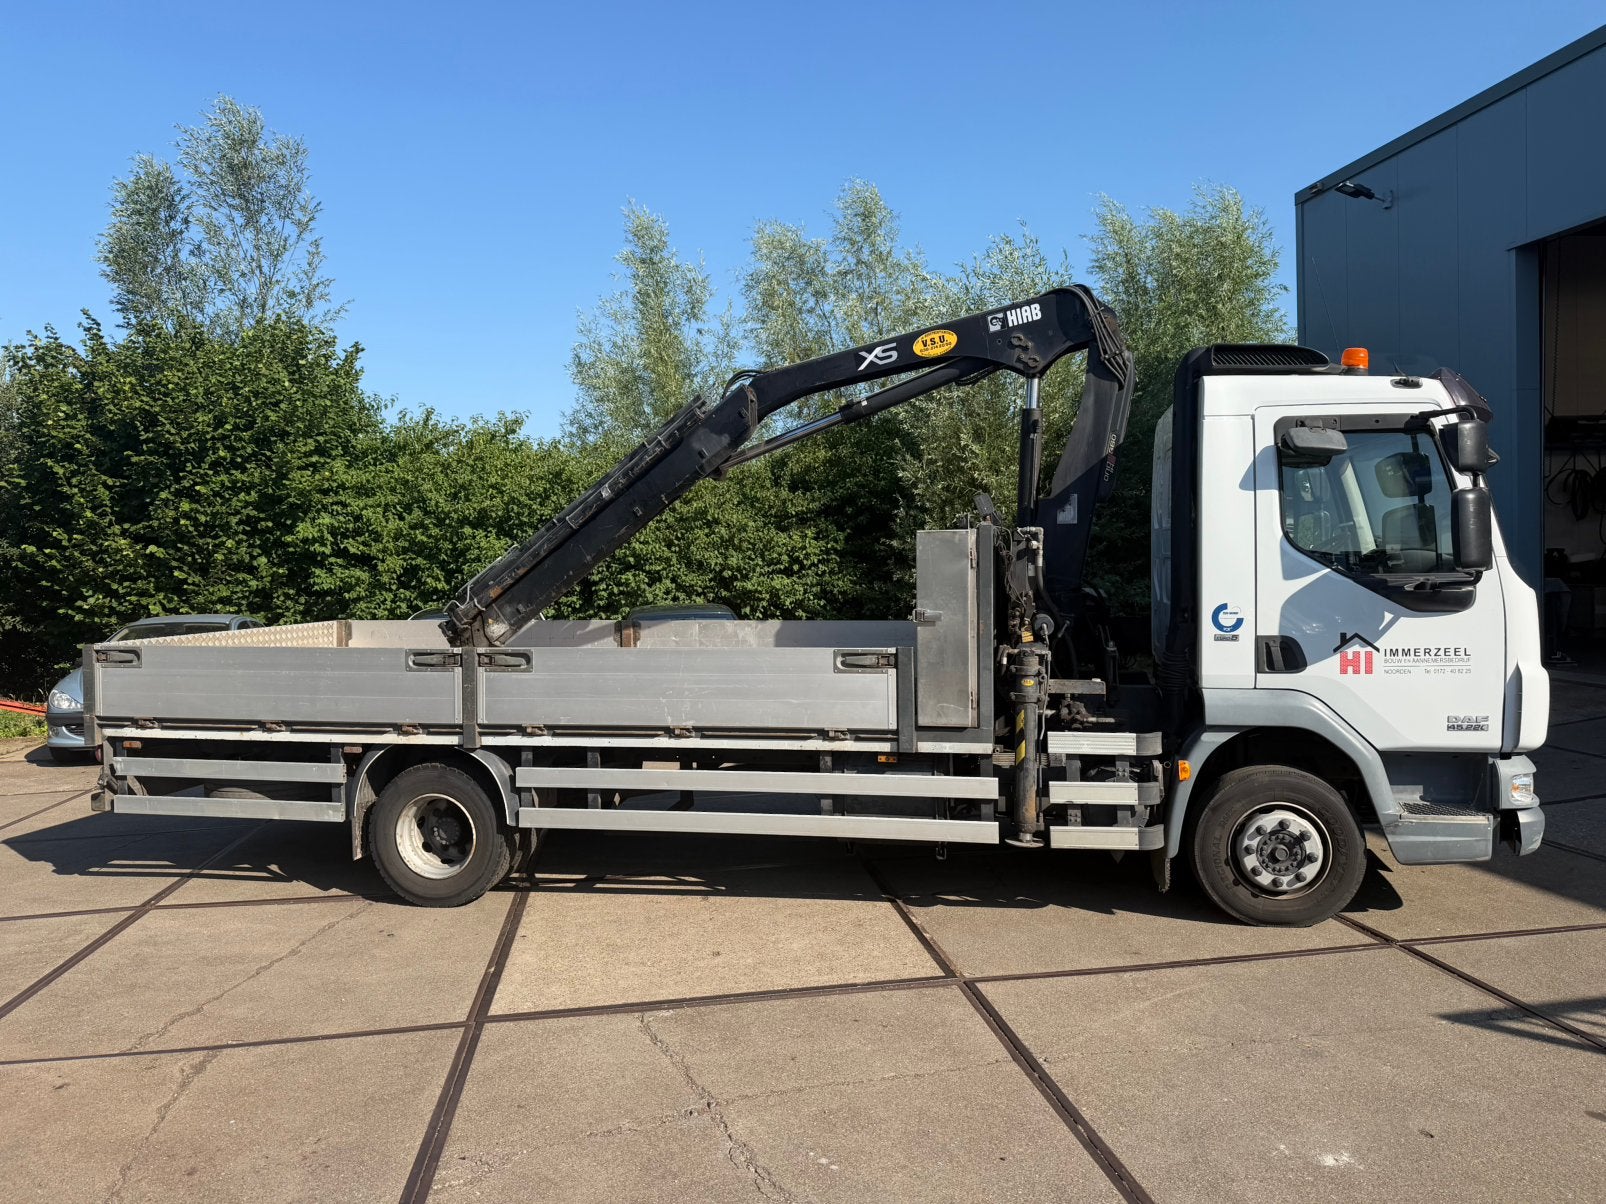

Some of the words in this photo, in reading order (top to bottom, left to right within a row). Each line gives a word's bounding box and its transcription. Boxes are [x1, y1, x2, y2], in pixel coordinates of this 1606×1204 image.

[1006, 303, 1042, 328] HIAB
[921, 334, 949, 348] V.S.U.
[857, 342, 898, 371] XS
[1383, 647, 1472, 658] IMMERZEEL
[1339, 651, 1373, 675] HI
[1446, 715, 1490, 724] DAF
